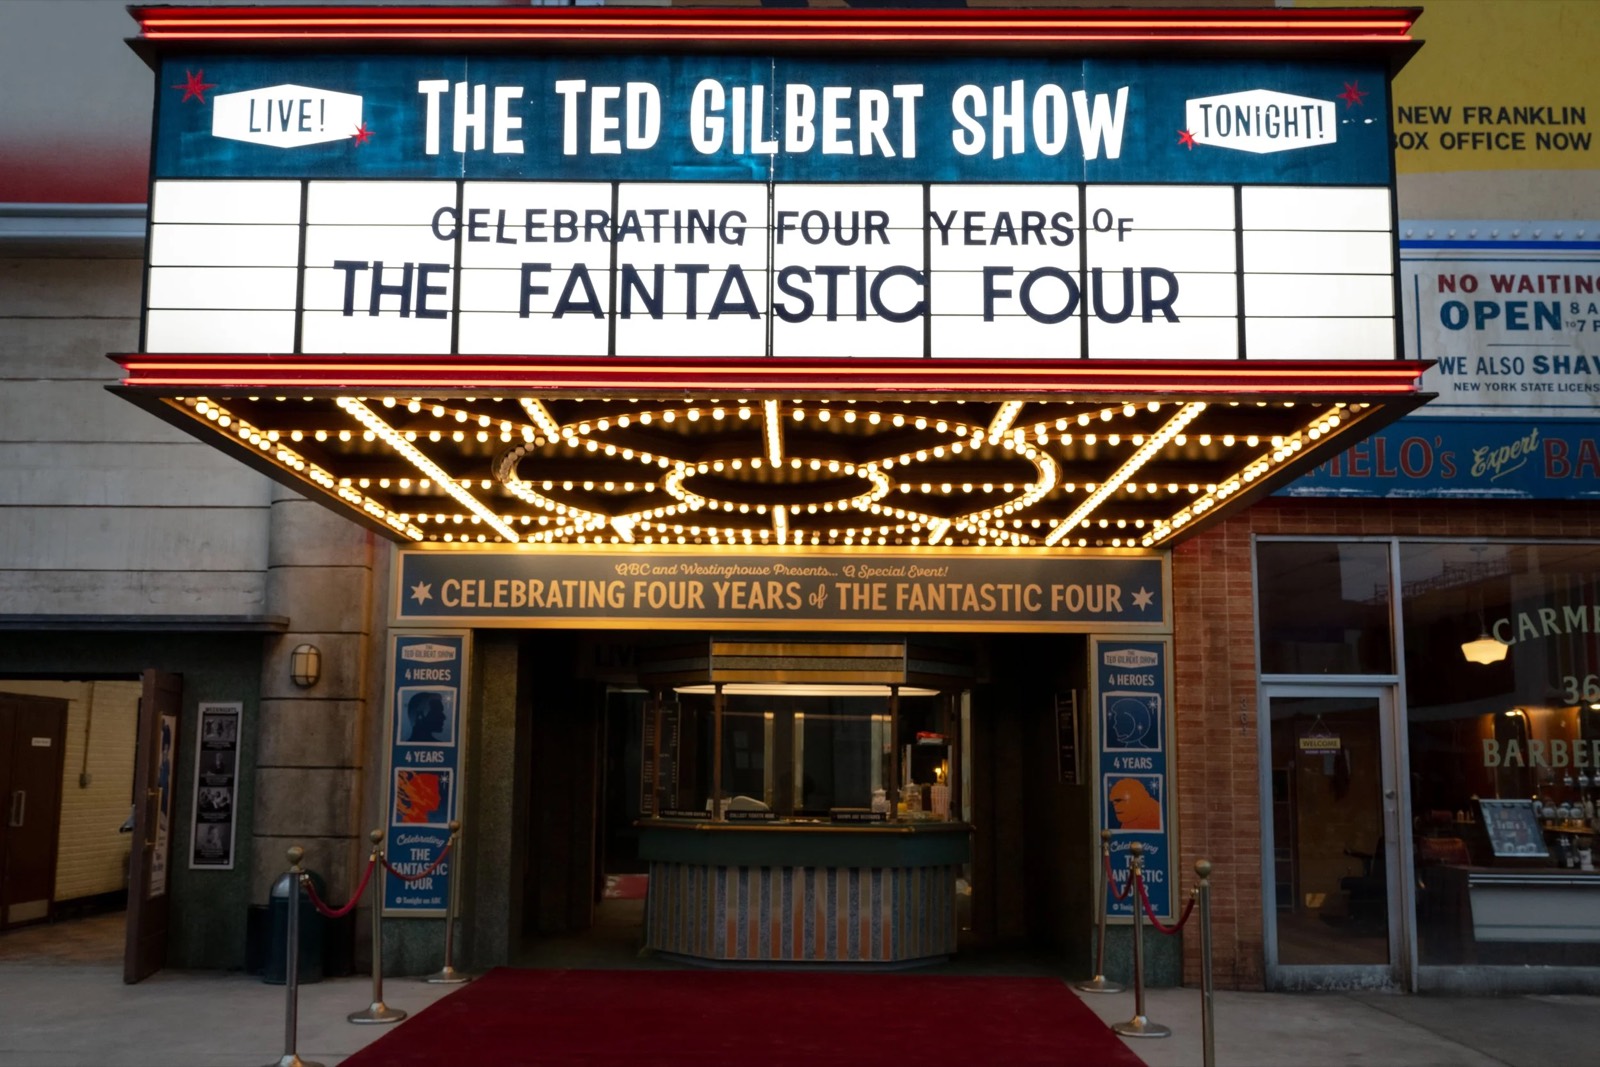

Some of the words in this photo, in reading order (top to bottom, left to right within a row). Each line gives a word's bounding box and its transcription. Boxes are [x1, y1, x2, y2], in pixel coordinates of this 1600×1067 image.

[249, 98, 325, 133] LIVE!
[418, 79, 525, 156] THE
[555, 79, 661, 156] TED
[690, 78, 924, 159] GILBERT
[952, 78, 1129, 160] SHOW
[1199, 103, 1325, 140] TONIGHT!
[1398, 106, 1452, 124] NEW
[1463, 106, 1587, 126] FRANKLIN
[1440, 131, 1526, 150] OFFICE
[1536, 132, 1592, 150] NOW
[431, 206, 747, 246] CELEBRATING
[775, 210, 891, 246] FOUR
[930, 211, 1074, 247] YEARS
[1092, 207, 1134, 242] OF
[333, 260, 450, 319] THE
[519, 262, 928, 324] FANTASTIC
[983, 265, 1180, 325] FOUR
[1438, 274, 1478, 293] NO
[1440, 300, 1562, 331] OPEN
[1570, 302, 1580, 314] 8
[1576, 320, 1586, 332] 7
[1438, 356, 1467, 375] WE
[1476, 356, 1525, 376] ALSO
[1454, 382, 1480, 391] NEW
[1485, 382, 1517, 392] YORK
[1520, 382, 1554, 392] STATE
[1470, 427, 1540, 478] Expert
[652, 563, 678, 577] and
[680, 563, 771, 580] Westinghouse
[858, 565, 907, 579] Special
[907, 565, 949, 578] Event!
[441, 578, 625, 608] CELEBRATING
[633, 580, 706, 610] FOUR
[712, 580, 802, 611] YEARS
[809, 582, 828, 609] of
[835, 582, 887, 611] THE
[896, 583, 1043, 612] FANTASTIC
[1051, 584, 1123, 613] FOUR
[405, 668, 412, 681] 4
[413, 668, 451, 681] HEROES
[1108, 674, 1115, 686] 4
[1117, 674, 1155, 686] HEROES
[404, 752, 412, 762] 4
[414, 752, 444, 763] YEARS
[1113, 757, 1121, 768] 4
[1121, 757, 1153, 769] YEARS
[397, 833, 445, 848] Celebrating
[410, 848, 431, 861] THE
